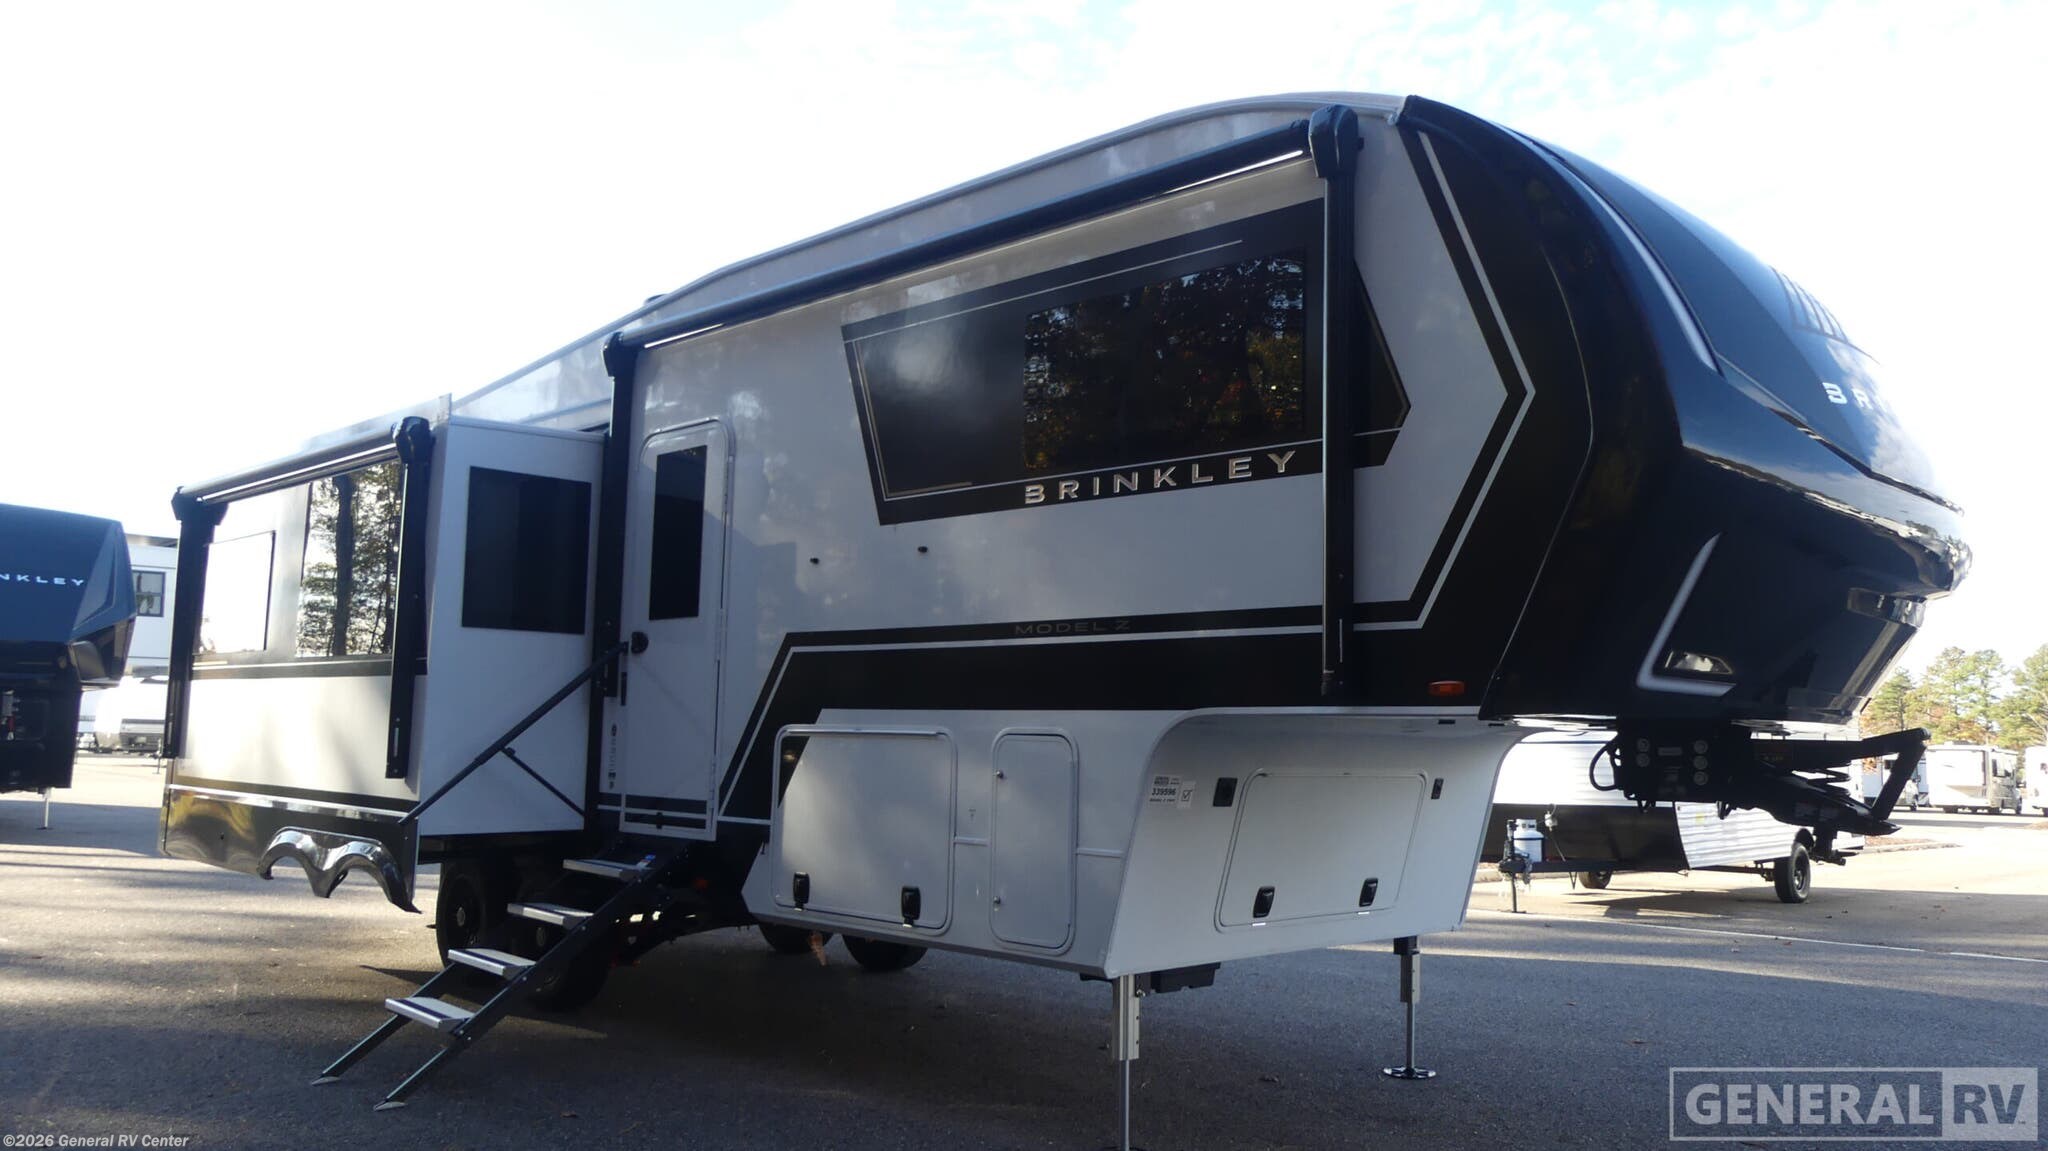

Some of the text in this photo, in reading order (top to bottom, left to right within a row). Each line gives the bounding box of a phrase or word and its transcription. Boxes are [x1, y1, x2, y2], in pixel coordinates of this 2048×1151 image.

[1025, 450, 1296, 505] BRINKLEY
[1015, 619, 1130, 635] MODEL Z
